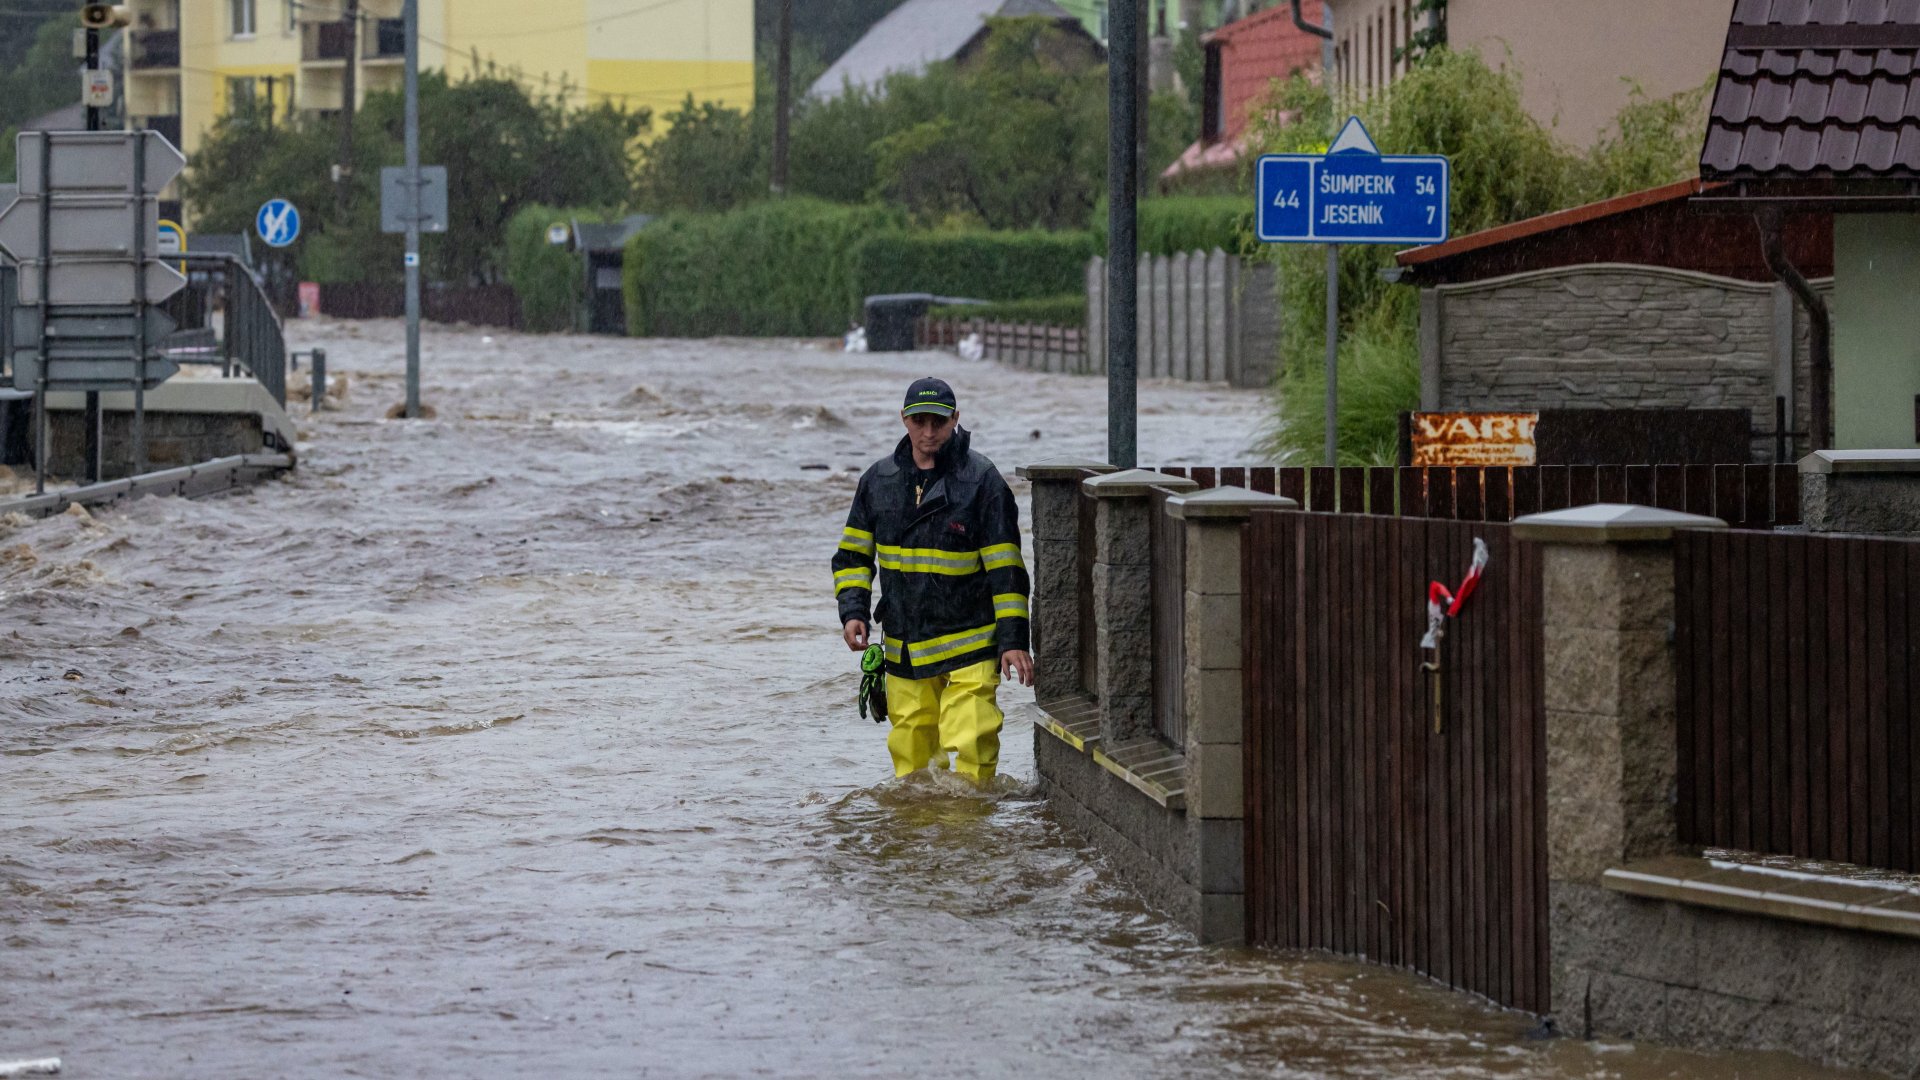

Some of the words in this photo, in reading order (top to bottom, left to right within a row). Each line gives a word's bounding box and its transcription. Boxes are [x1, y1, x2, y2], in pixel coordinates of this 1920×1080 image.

[1320, 170, 1395, 194] ŠUMPERK
[1416, 176, 1435, 194] 54
[1273, 190, 1299, 208] 44
[1320, 201, 1383, 224] JESENÍK
[1427, 206, 1435, 224] 7
